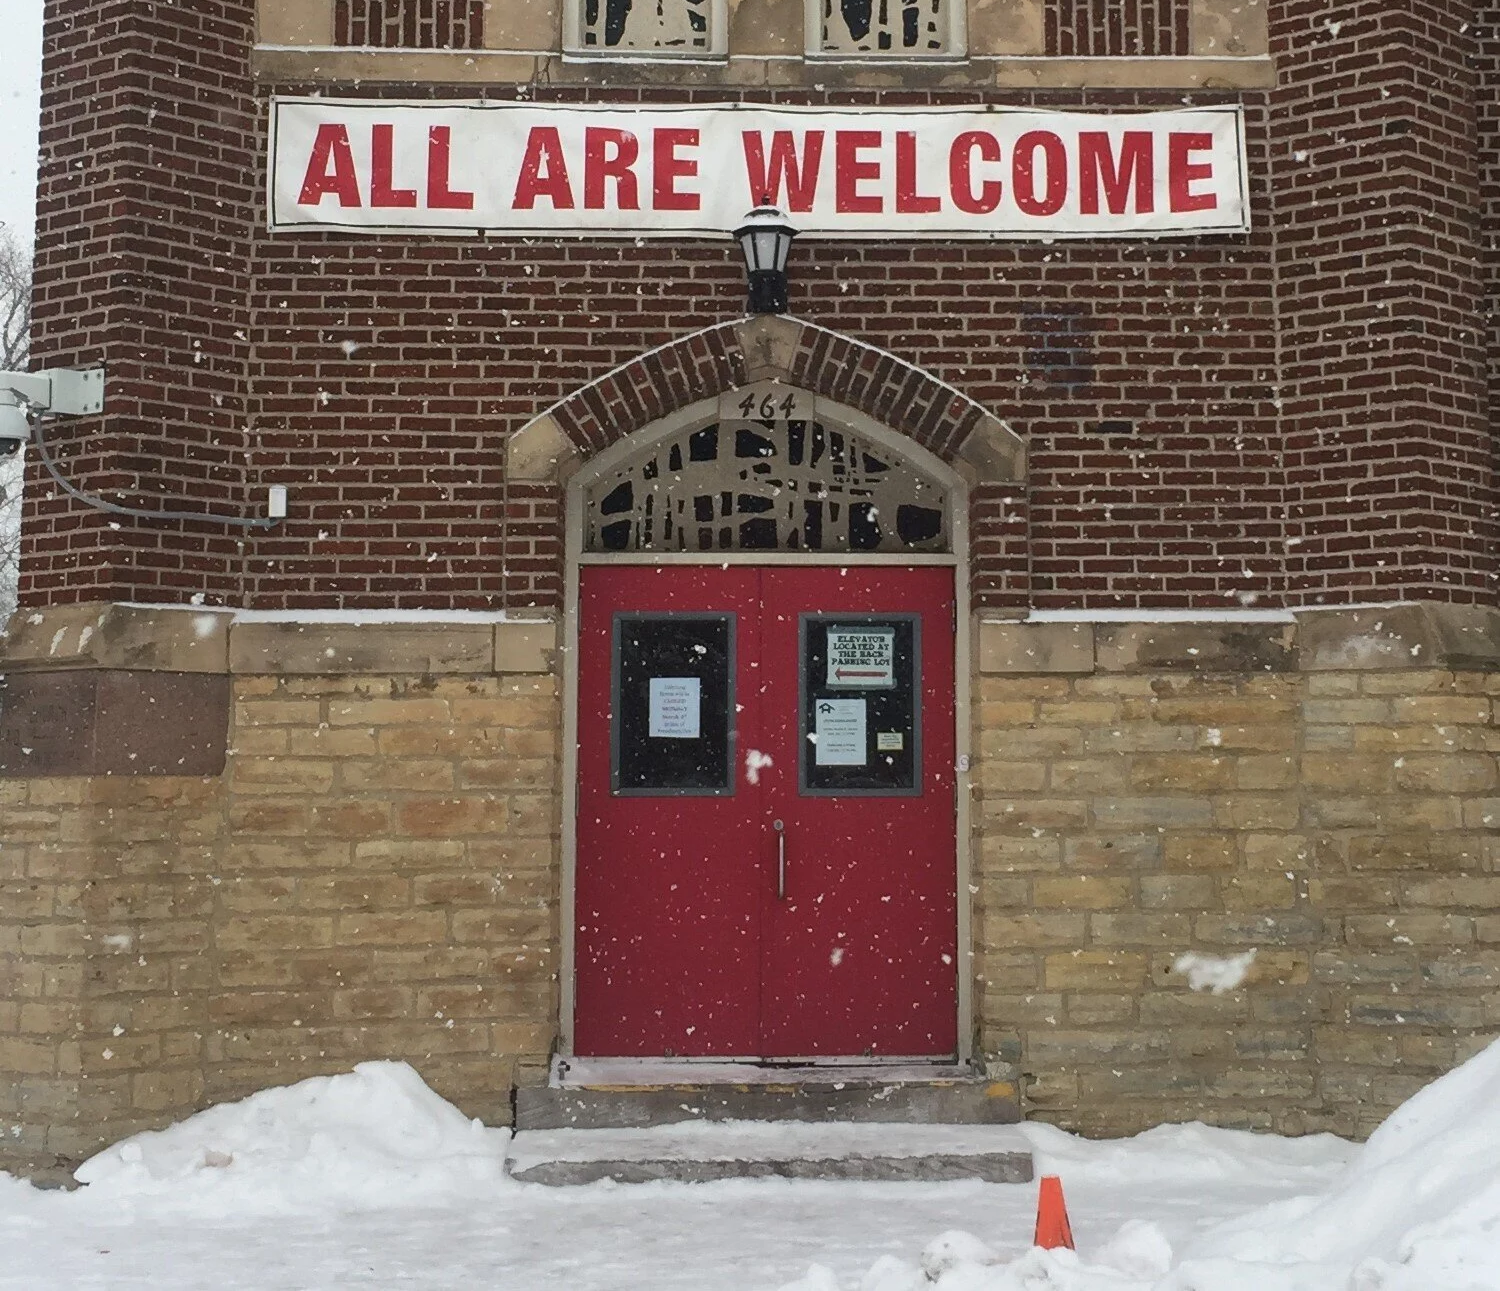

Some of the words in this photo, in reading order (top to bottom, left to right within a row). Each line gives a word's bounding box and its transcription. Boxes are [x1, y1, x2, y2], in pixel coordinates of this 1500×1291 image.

[297, 123, 475, 210] ALL
[510, 125, 701, 211] ARE
[741, 129, 1217, 216] WELCOME
[738, 392, 797, 419] 464
[837, 635, 885, 643] ELEVATOR
[831, 658, 871, 666] PARKING
